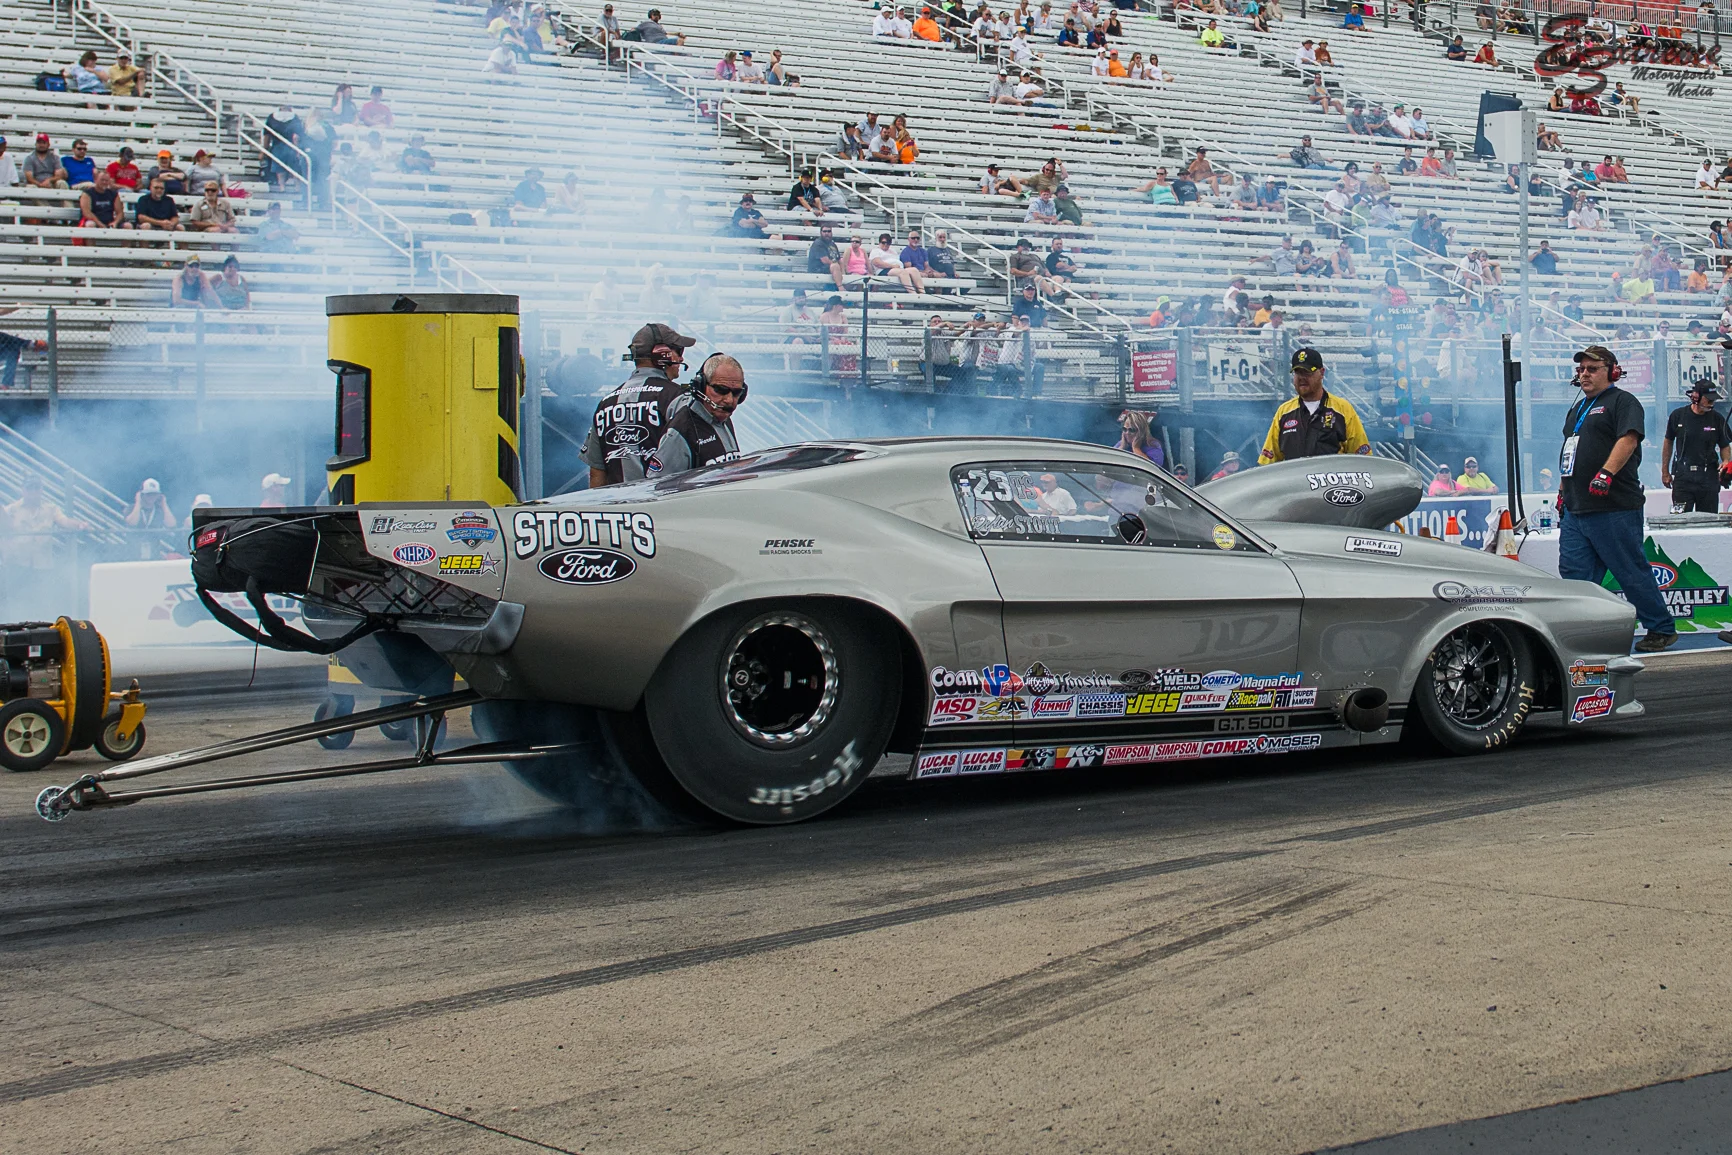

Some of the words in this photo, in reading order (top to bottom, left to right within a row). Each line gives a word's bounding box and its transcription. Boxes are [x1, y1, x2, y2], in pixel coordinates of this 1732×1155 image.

[1395, 323, 1413, 331] STAGE
[595, 400, 660, 437] STOTT'S
[613, 427, 641, 443] Ford
[968, 469, 1013, 502] 23
[1306, 471, 1374, 490] STOTT'S
[1331, 489, 1358, 503] Ford
[1014, 514, 1061, 534] STOTT
[513, 511, 656, 560] STOTT'S
[764, 539, 815, 548] PENSKE
[399, 546, 431, 561] NHRA
[442, 554, 483, 569] JEGS
[557, 552, 618, 579] Ford
[1440, 585, 1532, 598] OAKLEY
[1660, 589, 1726, 605] VALLEY
[931, 667, 981, 691] Coan
[982, 664, 1011, 696] VP
[1053, 669, 1111, 694] Hoosier
[1125, 673, 1146, 684] Ford
[1163, 674, 1201, 686] WELD
[1201, 673, 1242, 686] COMETIC
[1241, 674, 1301, 691] MagnaFuel
[1078, 701, 1124, 710] CHASSIS
[1126, 692, 1181, 714] JEGS
[1237, 690, 1273, 706] Racepak
[1577, 700, 1600, 711] LUCAS
[1600, 698, 1610, 708] OIL
[933, 697, 977, 715] MSD
[999, 700, 1028, 712] PAC
[1032, 698, 1072, 715] SUMMIT
[1247, 715, 1285, 730] 500
[1202, 740, 1248, 754] COMP
[1266, 745, 1315, 753] ENGINEERING
[1268, 735, 1321, 748] MOSER
[1065, 745, 1104, 768] K&N
[1107, 746, 1152, 759] SIMPSON
[1155, 743, 1199, 756] SIMPSON
[919, 754, 958, 770] LUCAS
[962, 751, 1004, 765] LUCAS
[920, 766, 941, 777] RACING
[941, 765, 953, 774] OIL
[961, 764, 981, 773] TRANS
[988, 763, 1001, 771] DIFF
